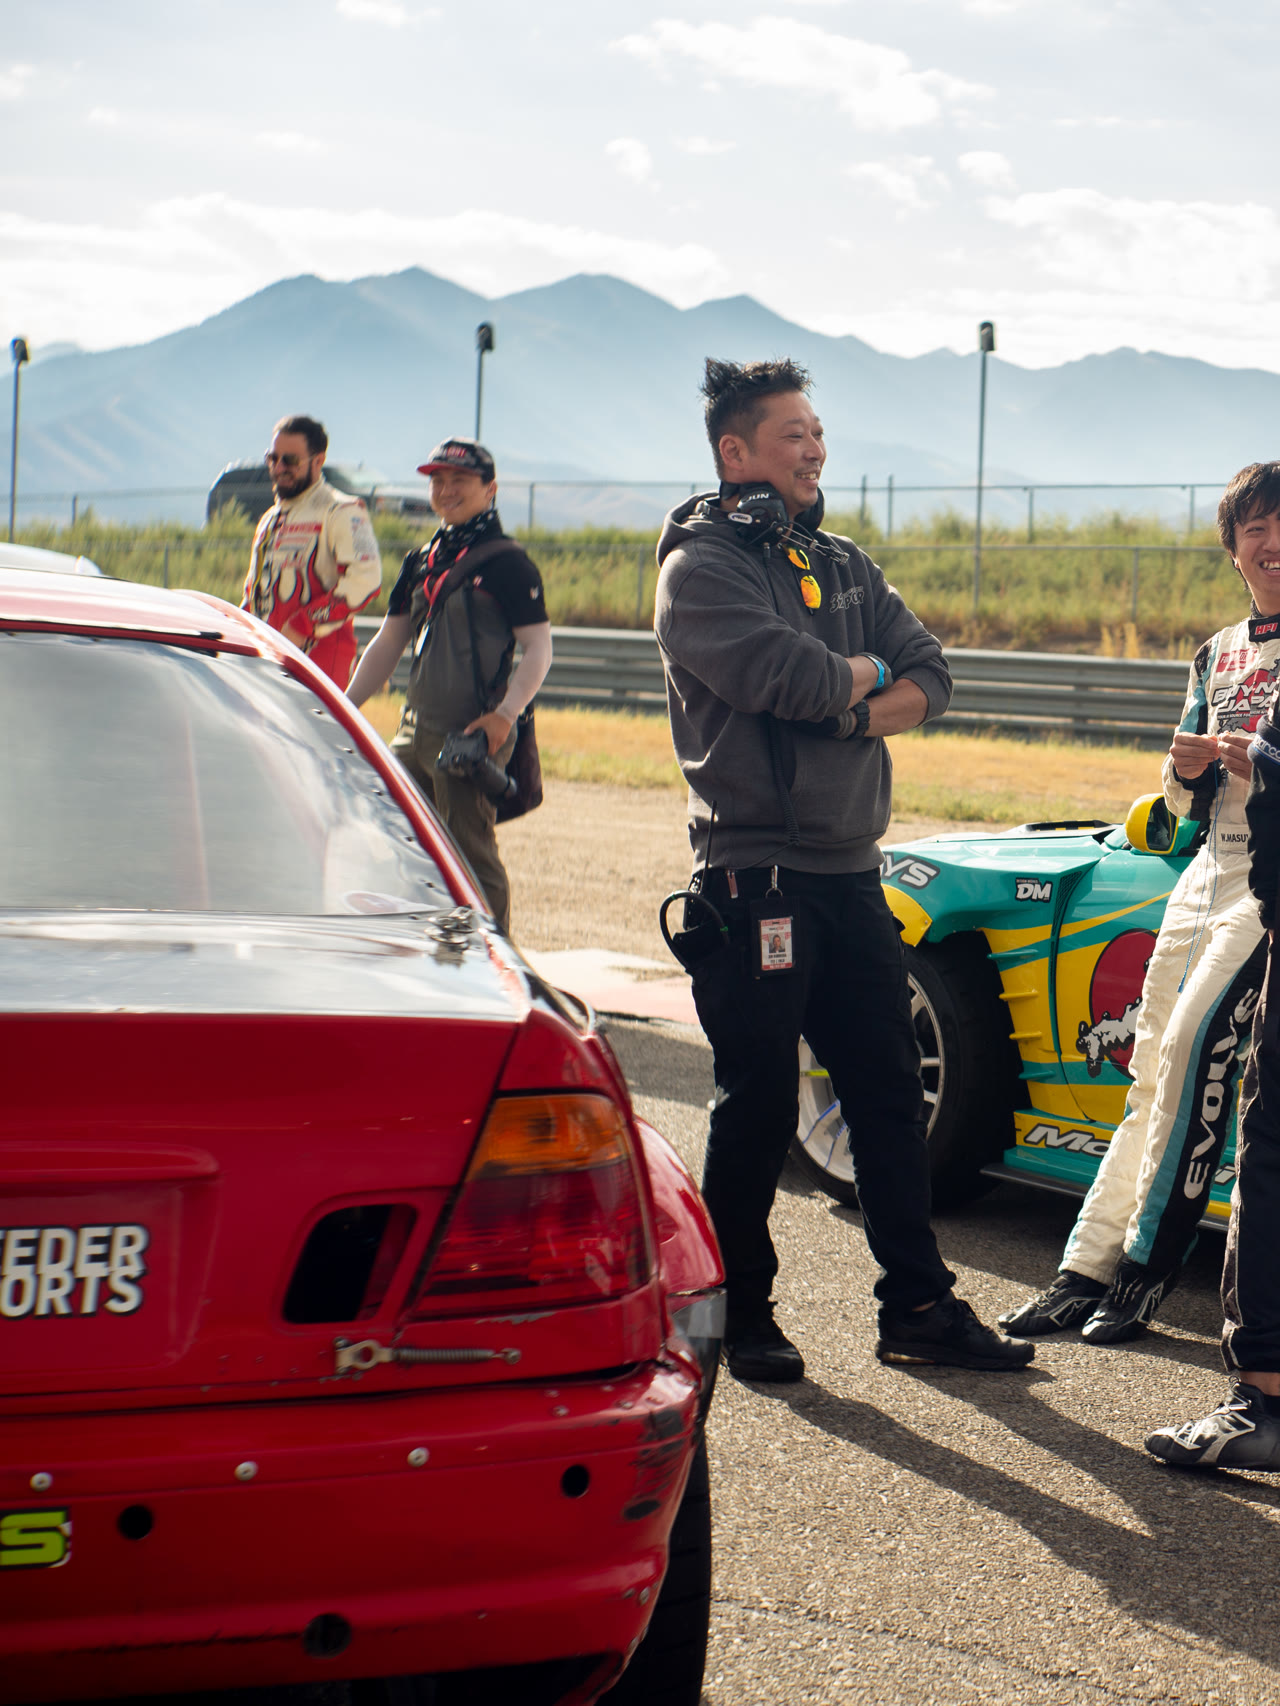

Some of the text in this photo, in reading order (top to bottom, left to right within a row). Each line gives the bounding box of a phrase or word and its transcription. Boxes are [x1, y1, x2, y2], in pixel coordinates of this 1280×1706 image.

[1254, 622, 1279, 636] HPI
[880, 853, 939, 889] YS
[1016, 883, 1052, 900] DM
[0, 1225, 150, 1277] EDER
[0, 1266, 143, 1318] ORTS
[0, 1511, 67, 1567] S
